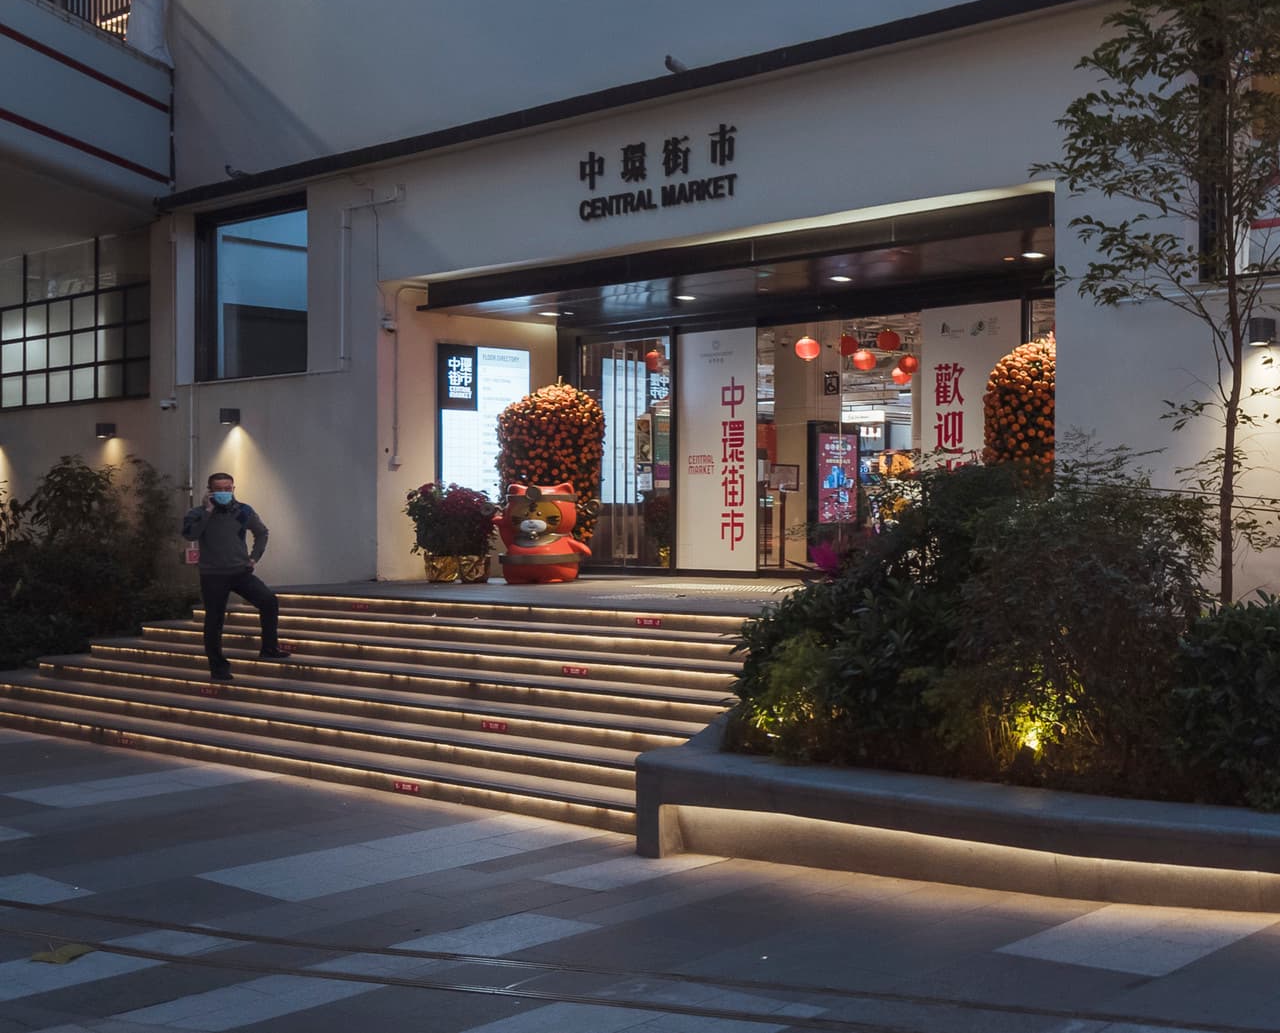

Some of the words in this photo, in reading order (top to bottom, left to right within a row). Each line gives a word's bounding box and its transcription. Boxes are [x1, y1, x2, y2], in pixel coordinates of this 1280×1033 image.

[579, 123, 737, 190] 中環街市
[579, 188, 657, 221] CENTRAL
[661, 173, 738, 207] MARKET
[934, 363, 966, 473] 歡迎
[721, 376, 745, 551] 中環街市
